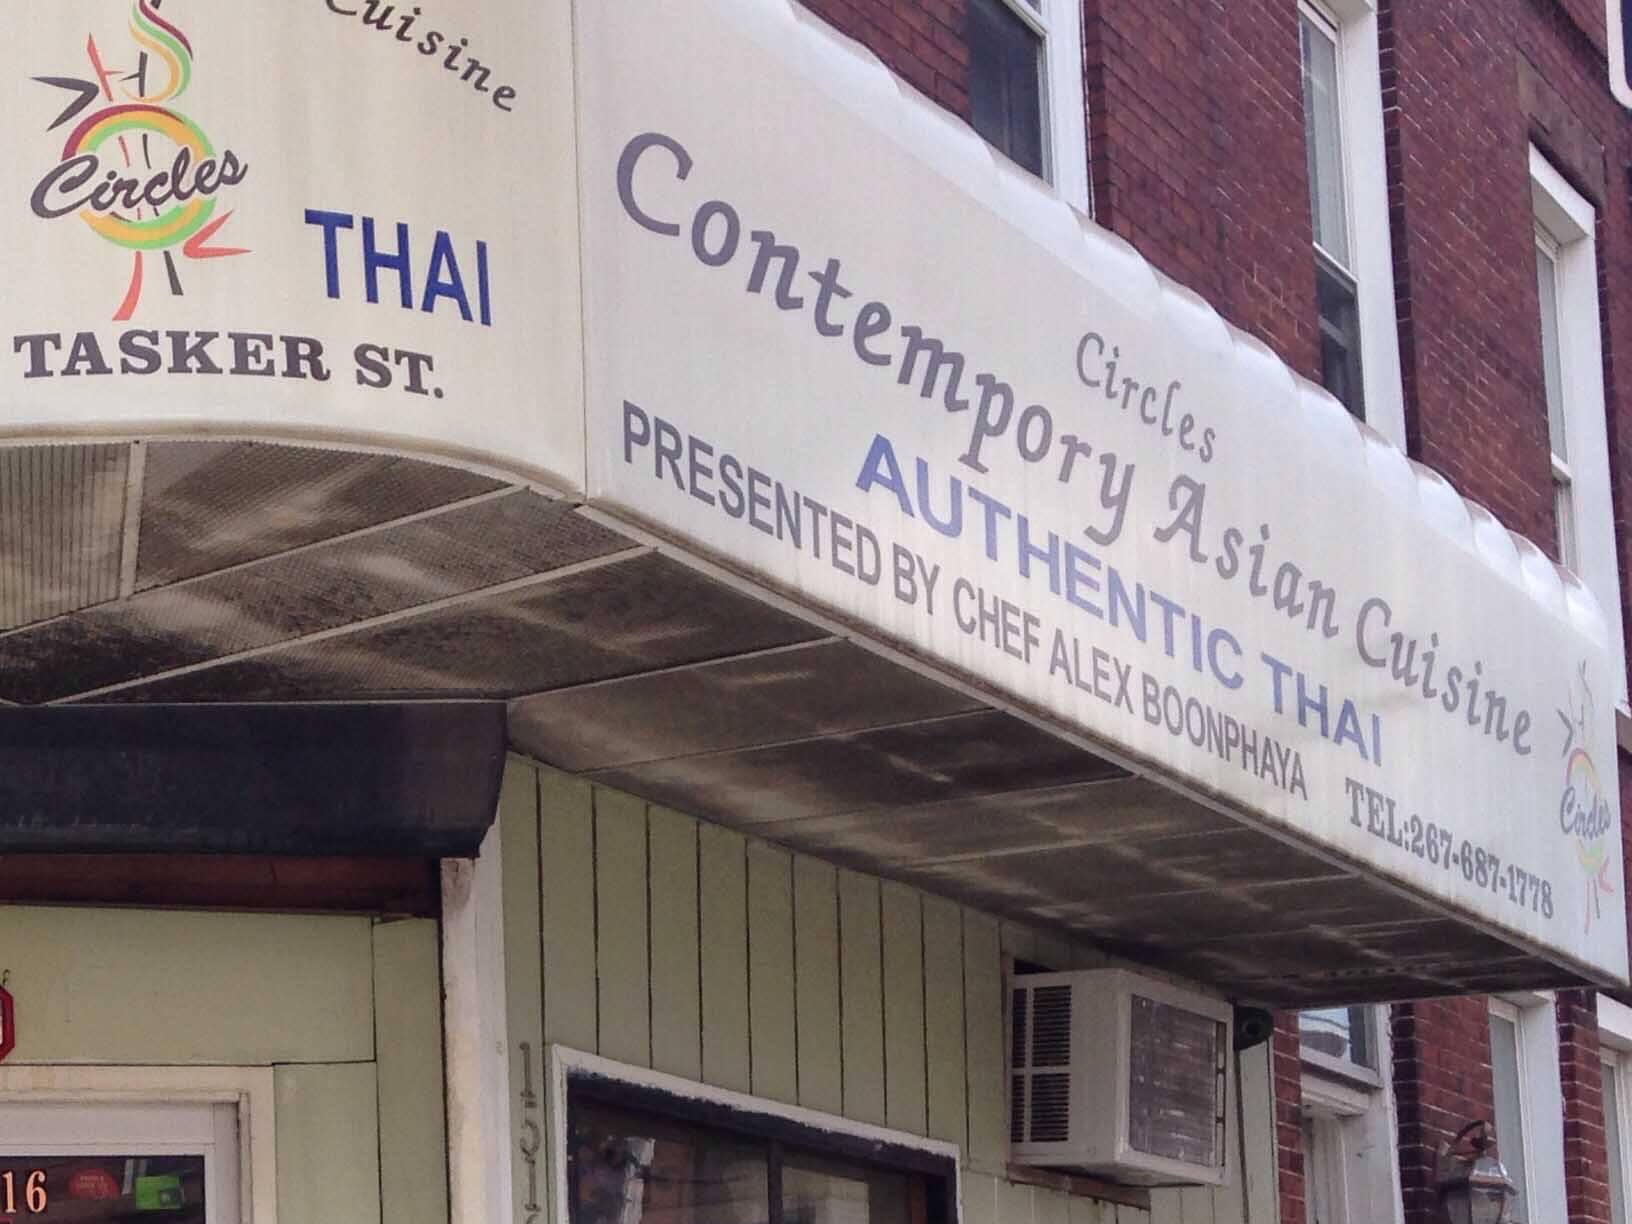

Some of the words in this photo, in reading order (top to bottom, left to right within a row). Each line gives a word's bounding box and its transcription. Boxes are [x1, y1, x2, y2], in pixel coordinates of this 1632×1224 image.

[29, 144, 249, 221] Circles
[304, 208, 494, 327] THAI
[13, 330, 332, 384] TASKER
[353, 345, 445, 399] ST.
[1076, 332, 1215, 464] Circles
[616, 132, 1136, 546] Contempory
[1152, 474, 1339, 639] Asian
[1355, 597, 1532, 755] Cuisine
[622, 400, 882, 587] PRESENTED
[892, 542, 941, 617] BY
[952, 577, 1041, 665] CHEF
[1050, 628, 1135, 714] ALEX
[1142, 674, 1308, 801] BOONPHAYA
[855, 433, 1244, 690] AUTHENTIC
[1261, 651, 1383, 767] THAI
